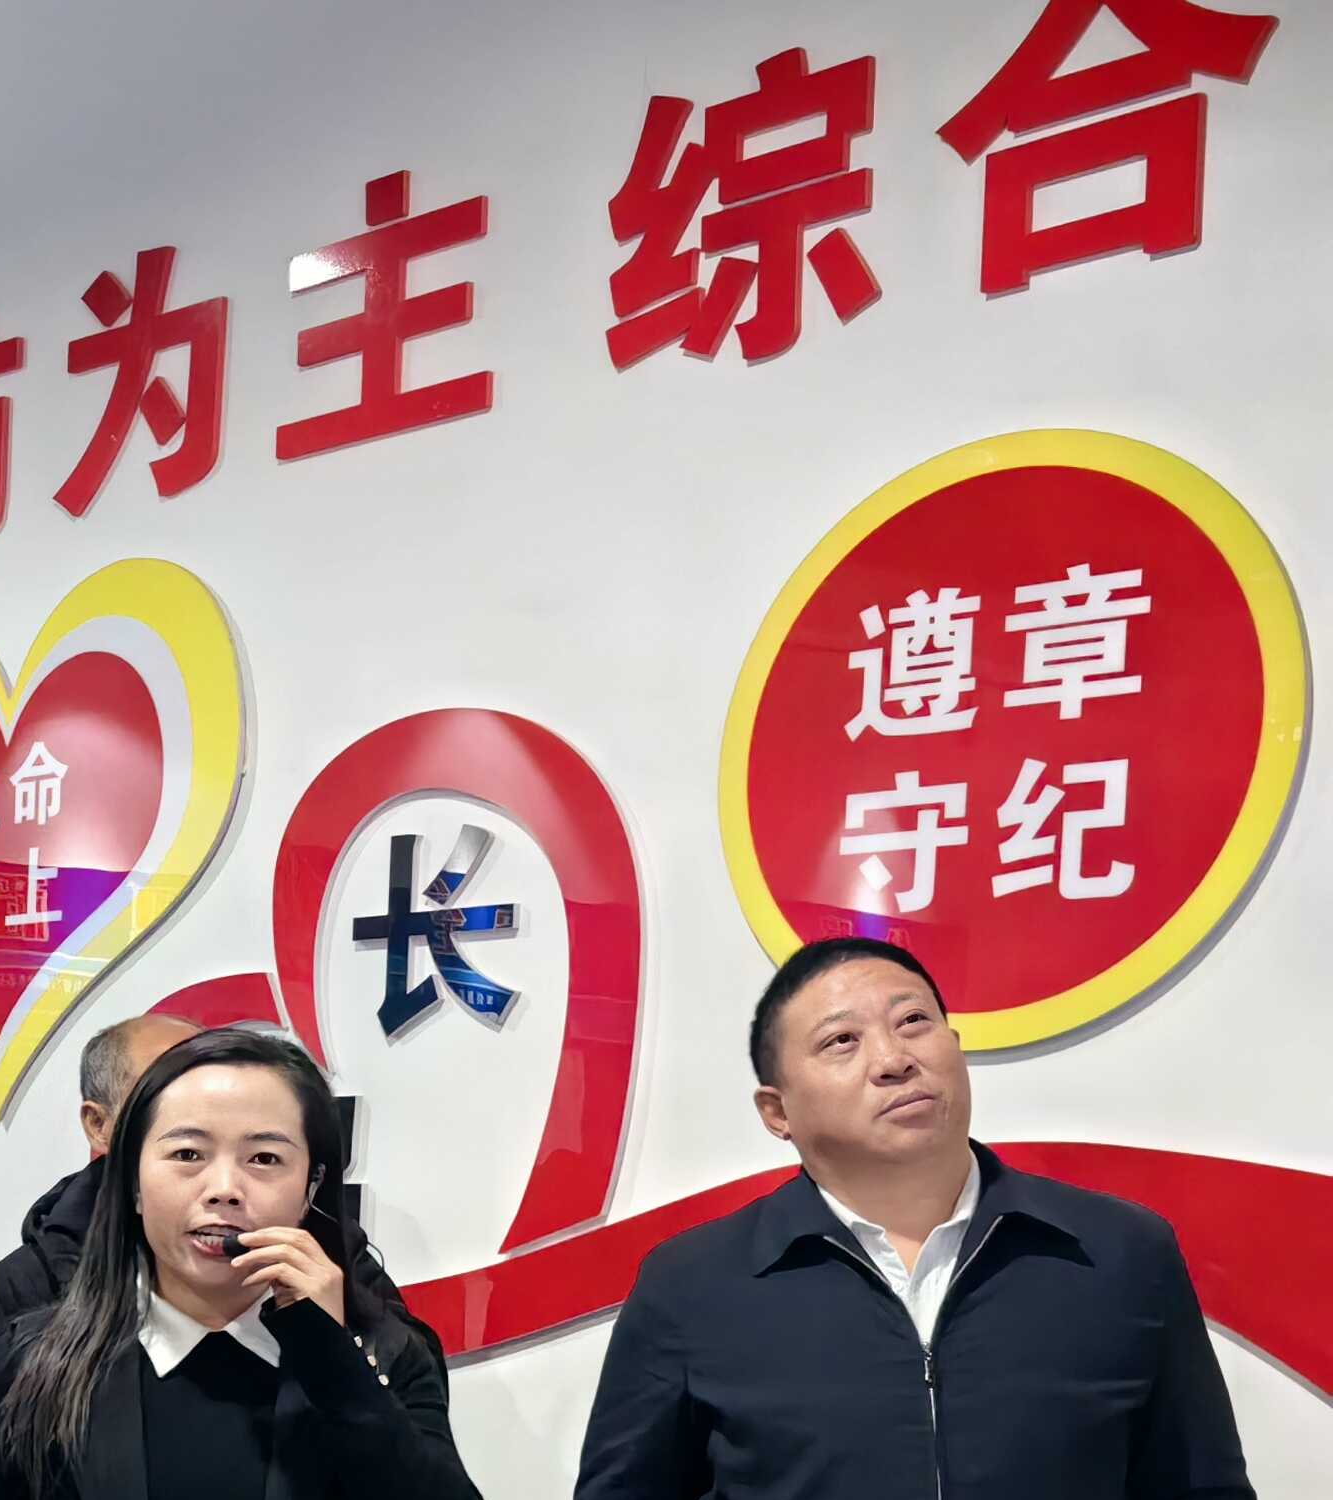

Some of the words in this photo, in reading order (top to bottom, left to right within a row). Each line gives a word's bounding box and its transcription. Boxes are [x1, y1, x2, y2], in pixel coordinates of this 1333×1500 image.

[606, 0, 1279, 372] 综合
[844, 563, 1151, 742] 遵章
[353, 824, 520, 1044] 长
[839, 758, 1135, 912] 守纪
